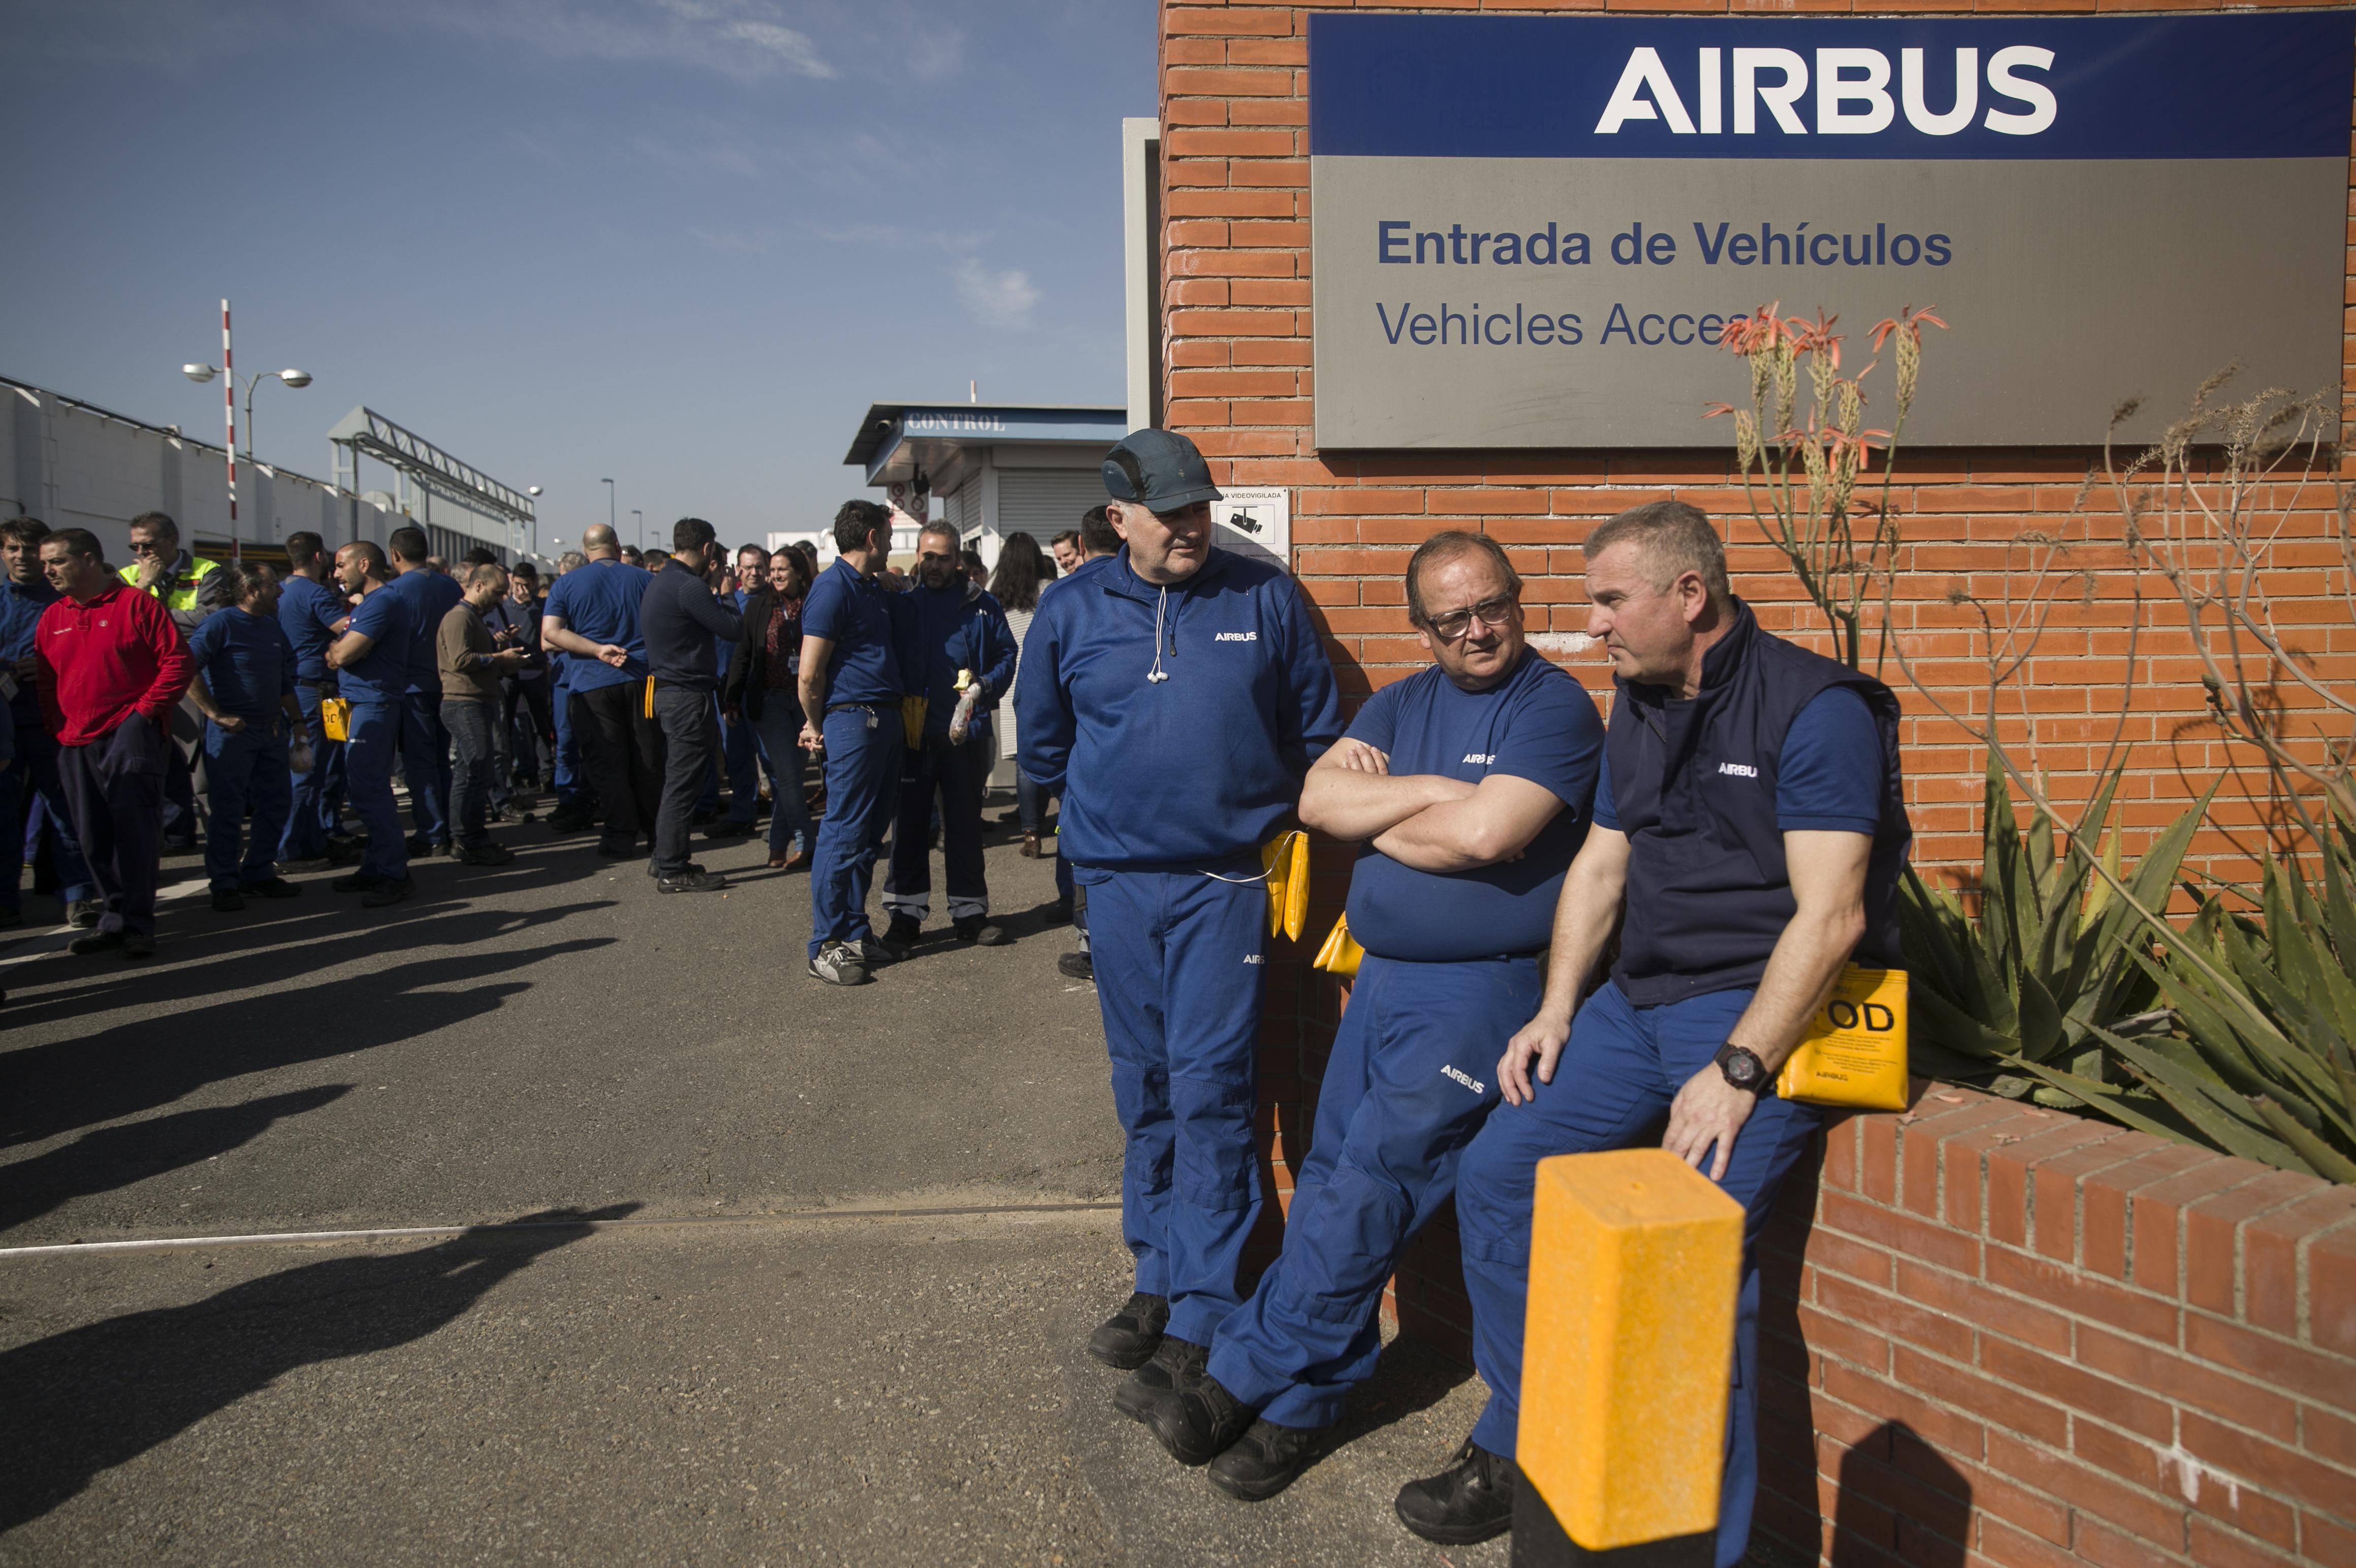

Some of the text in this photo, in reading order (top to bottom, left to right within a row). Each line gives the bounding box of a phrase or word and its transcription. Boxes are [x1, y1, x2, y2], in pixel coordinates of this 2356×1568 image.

[1594, 45, 2057, 136] AIRBUS
[1377, 221, 1952, 266] Entrada de Vehículos
[1376, 303, 1777, 346] Vehicles Acce
[907, 413, 1006, 432] CONTROL
[1215, 631, 1257, 642] AIRBUS
[1440, 1064, 1485, 1094] AIRBUS
